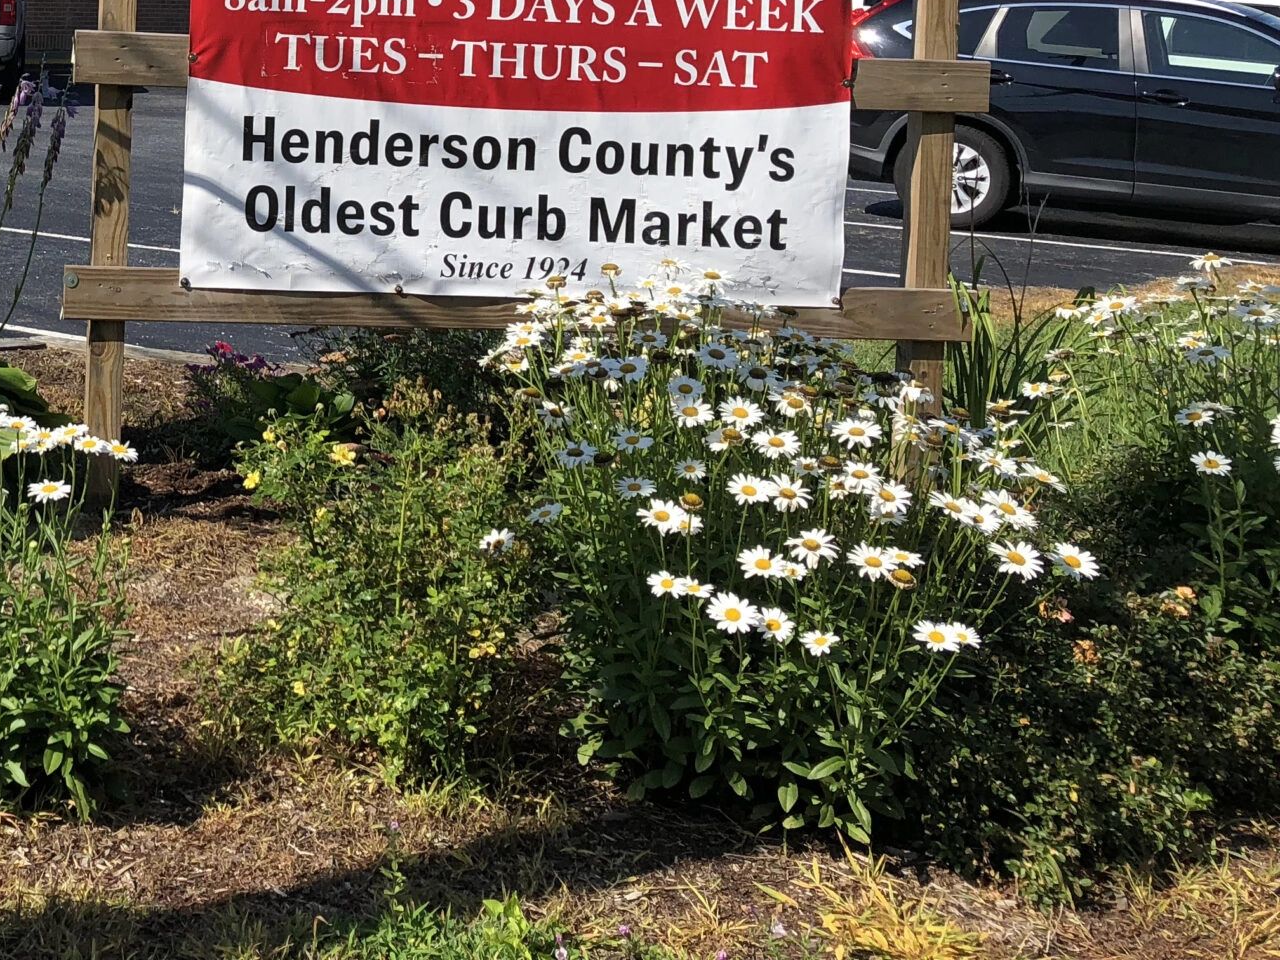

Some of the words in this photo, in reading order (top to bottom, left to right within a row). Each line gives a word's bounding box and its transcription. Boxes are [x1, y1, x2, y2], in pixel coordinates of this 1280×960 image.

[274, 31, 407, 75] TUES
[451, 38, 627, 83] THURS
[673, 50, 769, 89] SAT
[242, 115, 536, 171] Henderson
[559, 126, 795, 192] County's
[245, 184, 420, 237] Oldest
[439, 191, 567, 242] Curb
[589, 197, 787, 251] Market
[440, 254, 513, 281] Since
